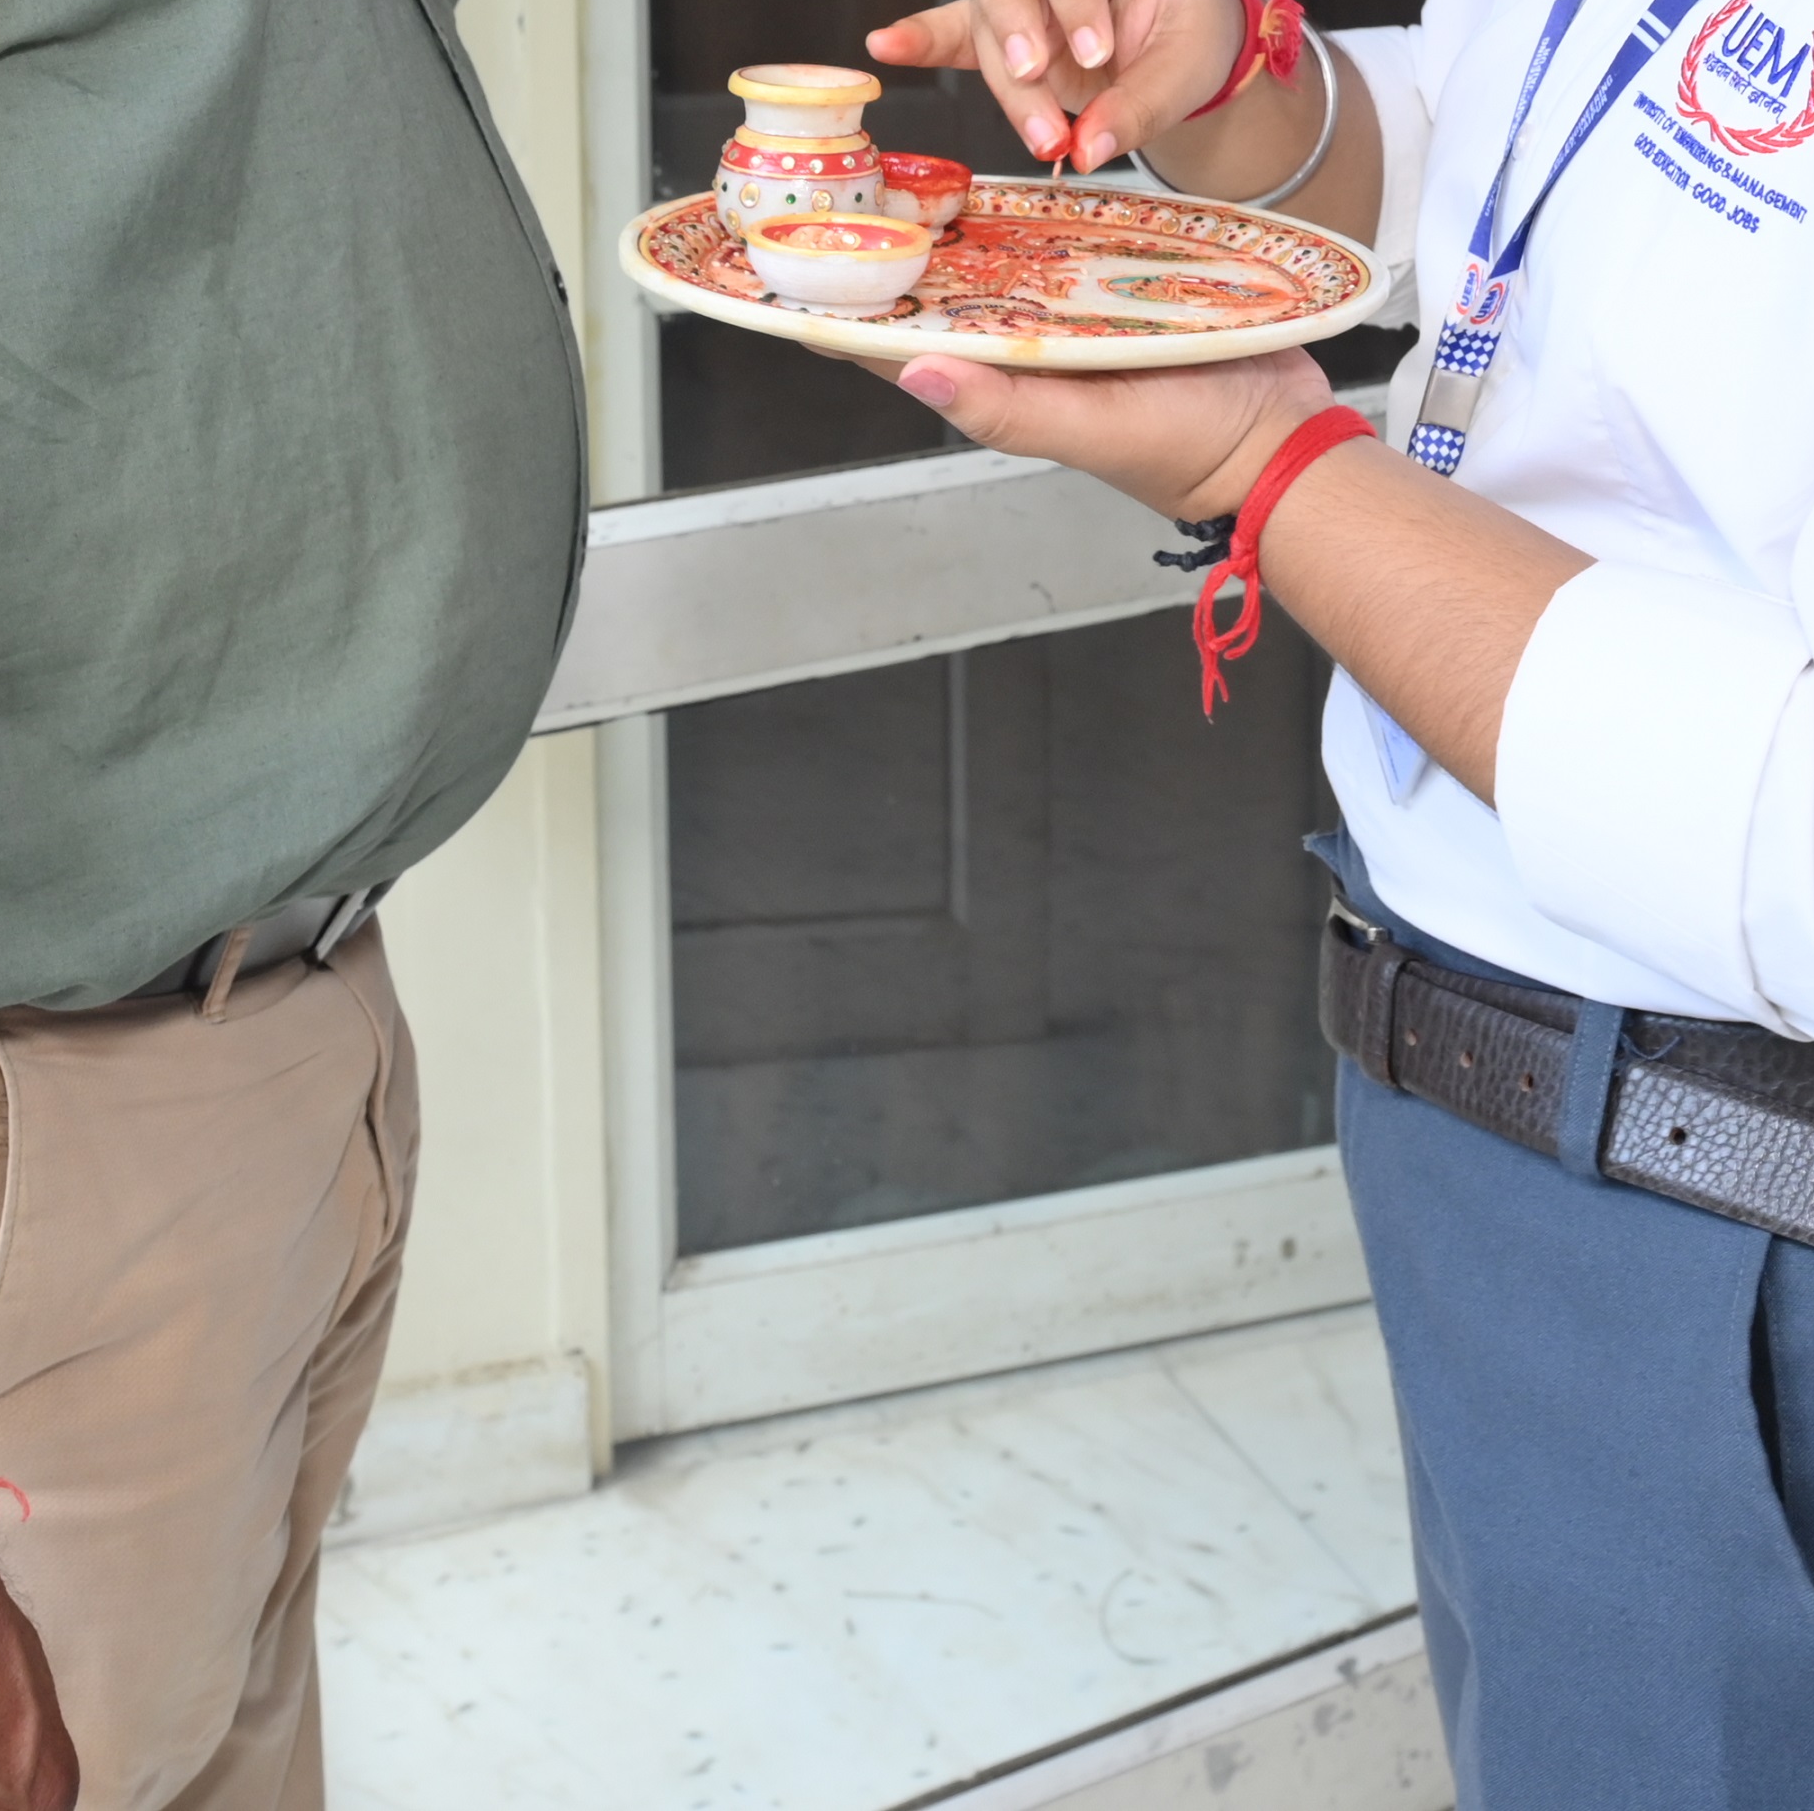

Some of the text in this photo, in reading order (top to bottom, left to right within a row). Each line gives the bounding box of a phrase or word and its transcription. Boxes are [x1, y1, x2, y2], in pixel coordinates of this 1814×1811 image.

[1721, 4, 1811, 98] UEM
[1692, 182, 1726, 213] GOOD
[1726, 204, 1760, 233] JOBS
[1721, 162, 1733, 179] &
[1730, 166, 1808, 223] MANAGEMENT
[1461, 271, 1477, 307] UEM
[1475, 290, 1498, 318] UEM
